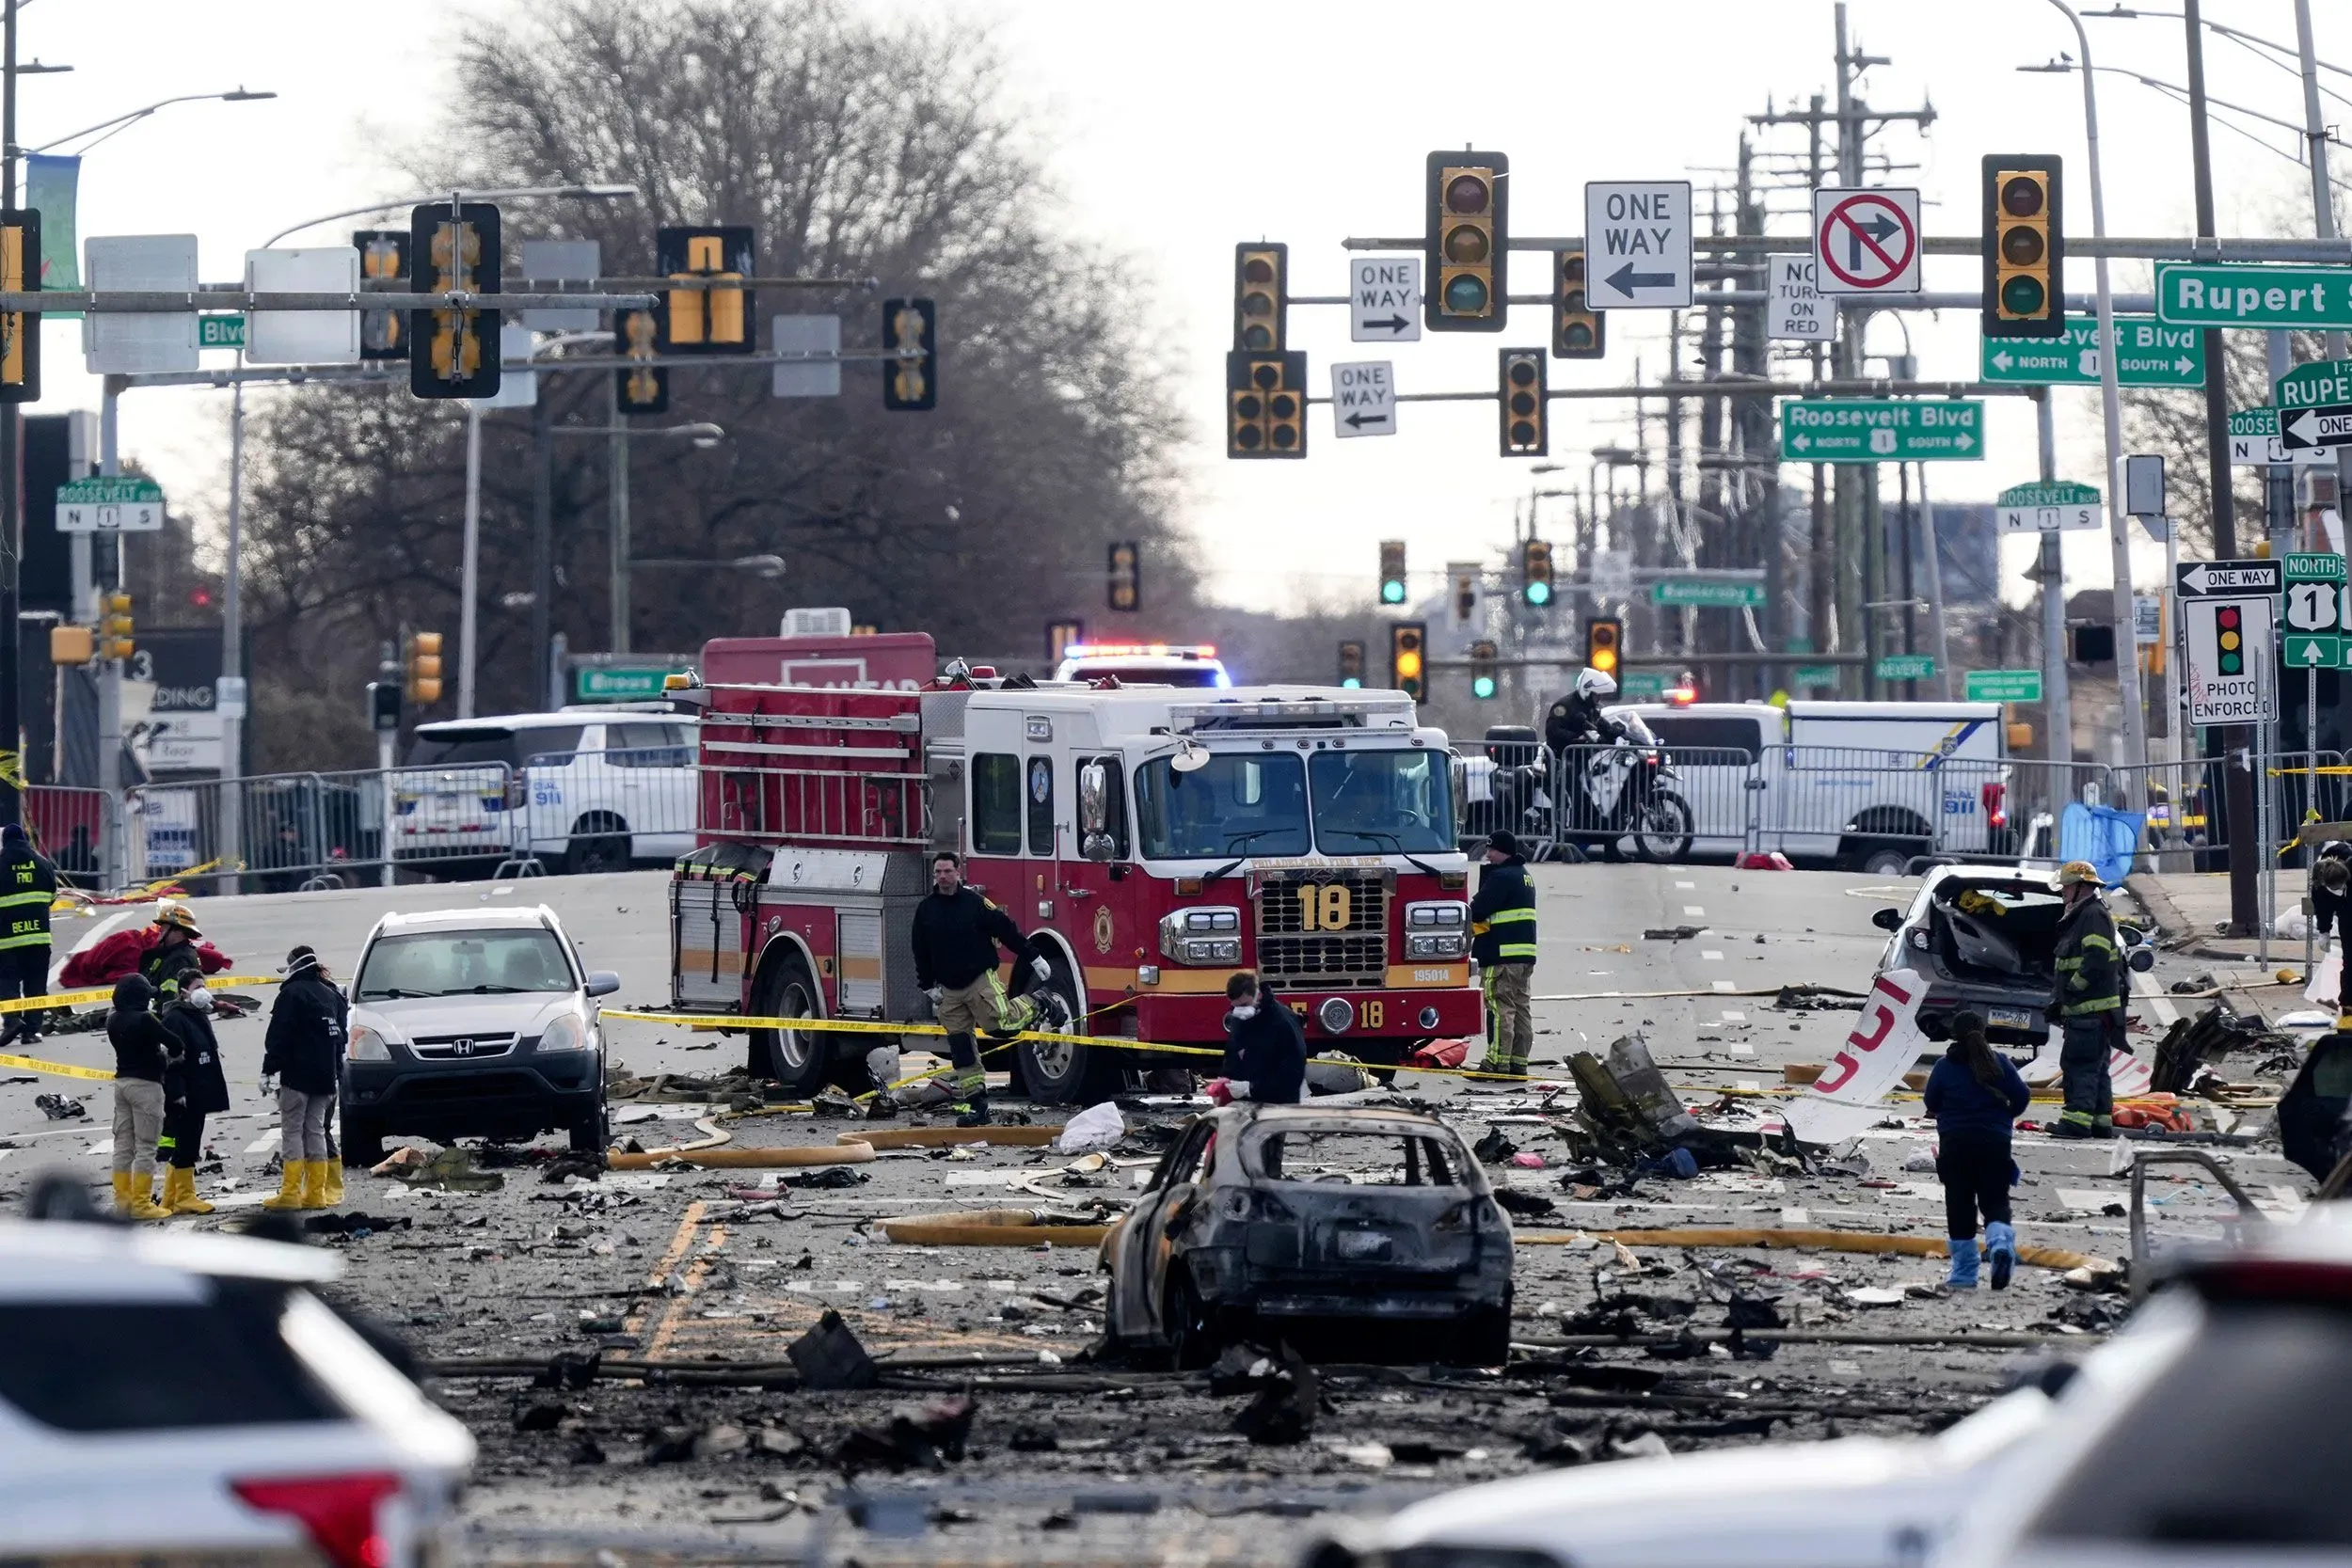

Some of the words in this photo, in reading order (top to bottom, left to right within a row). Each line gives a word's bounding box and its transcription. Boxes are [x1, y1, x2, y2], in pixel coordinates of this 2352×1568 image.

[1607, 193, 1671, 221] ONE
[1605, 228, 1672, 256] WAY
[1361, 265, 1411, 284] ONE
[1360, 289, 1411, 309] WAY
[1779, 285, 1817, 299] TUR
[2179, 278, 2326, 317] Rupert
[1791, 302, 1814, 316] ON
[1785, 320, 1820, 333] RED
[2136, 325, 2195, 348] Blvd
[2019, 356, 2068, 369] NORTH
[2122, 358, 2169, 371] SOUTH
[1341, 368, 1386, 387] ONE
[1342, 388, 1387, 407] WAY
[2283, 377, 2352, 405] RUPE
[1790, 406, 1912, 427] Roosevelt
[1920, 407, 1974, 426] Blvd
[2228, 417, 2279, 435] ROOSE
[2319, 417, 2352, 434] ONE
[1816, 436, 1861, 448] NORTH
[1908, 436, 1951, 449] SOUTH
[2235, 442, 2249, 457] N
[57, 486, 135, 503] ROOSEVELT
[1998, 488, 2075, 505] ROOSEVELT
[2079, 492, 2099, 502] BLVD
[68, 509, 81, 524] N
[138, 509, 151, 524] S
[2009, 512, 2021, 527] N
[2079, 510, 2090, 524] S
[2289, 557, 2336, 574] NORTH
[2208, 572, 2236, 585] ONE
[2241, 570, 2270, 584] WAY
[2304, 590, 2317, 623] 1
[536, 792, 562, 806] 911
[1944, 800, 1976, 815] 911
[1251, 858, 1325, 868] PHILADELPHIA
[1328, 858, 1354, 867] FIRE
[1297, 885, 1350, 931] 18
[12, 920, 40, 933] BEALE
[1414, 970, 1449, 981] 195014
[1360, 1001, 1384, 1028] 18
